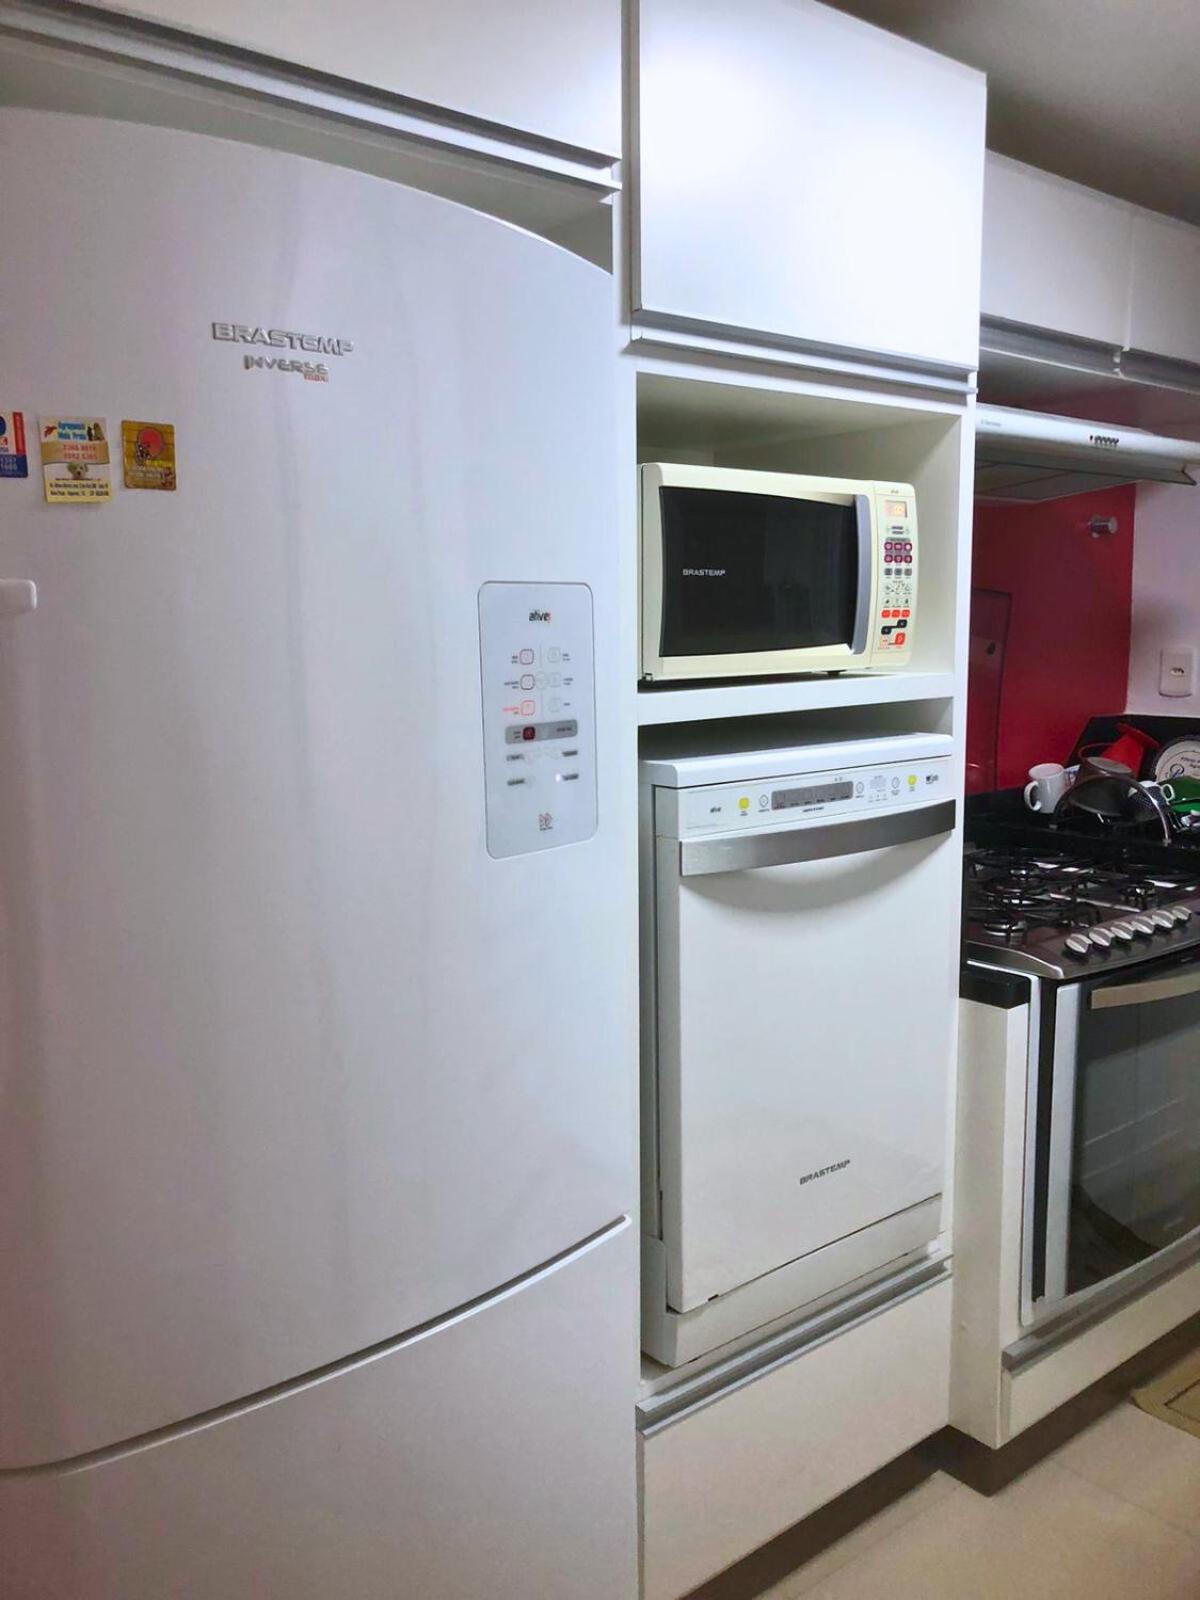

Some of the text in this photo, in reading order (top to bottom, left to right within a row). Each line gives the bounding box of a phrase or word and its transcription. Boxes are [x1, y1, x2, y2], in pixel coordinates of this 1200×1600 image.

[212, 322, 354, 356] BRASTEMP
[244, 355, 329, 375] INVERSE
[682, 568, 726, 577] BRASTEMP
[529, 610, 551, 623] alive
[800, 1159, 850, 1186] BRASTEMP
